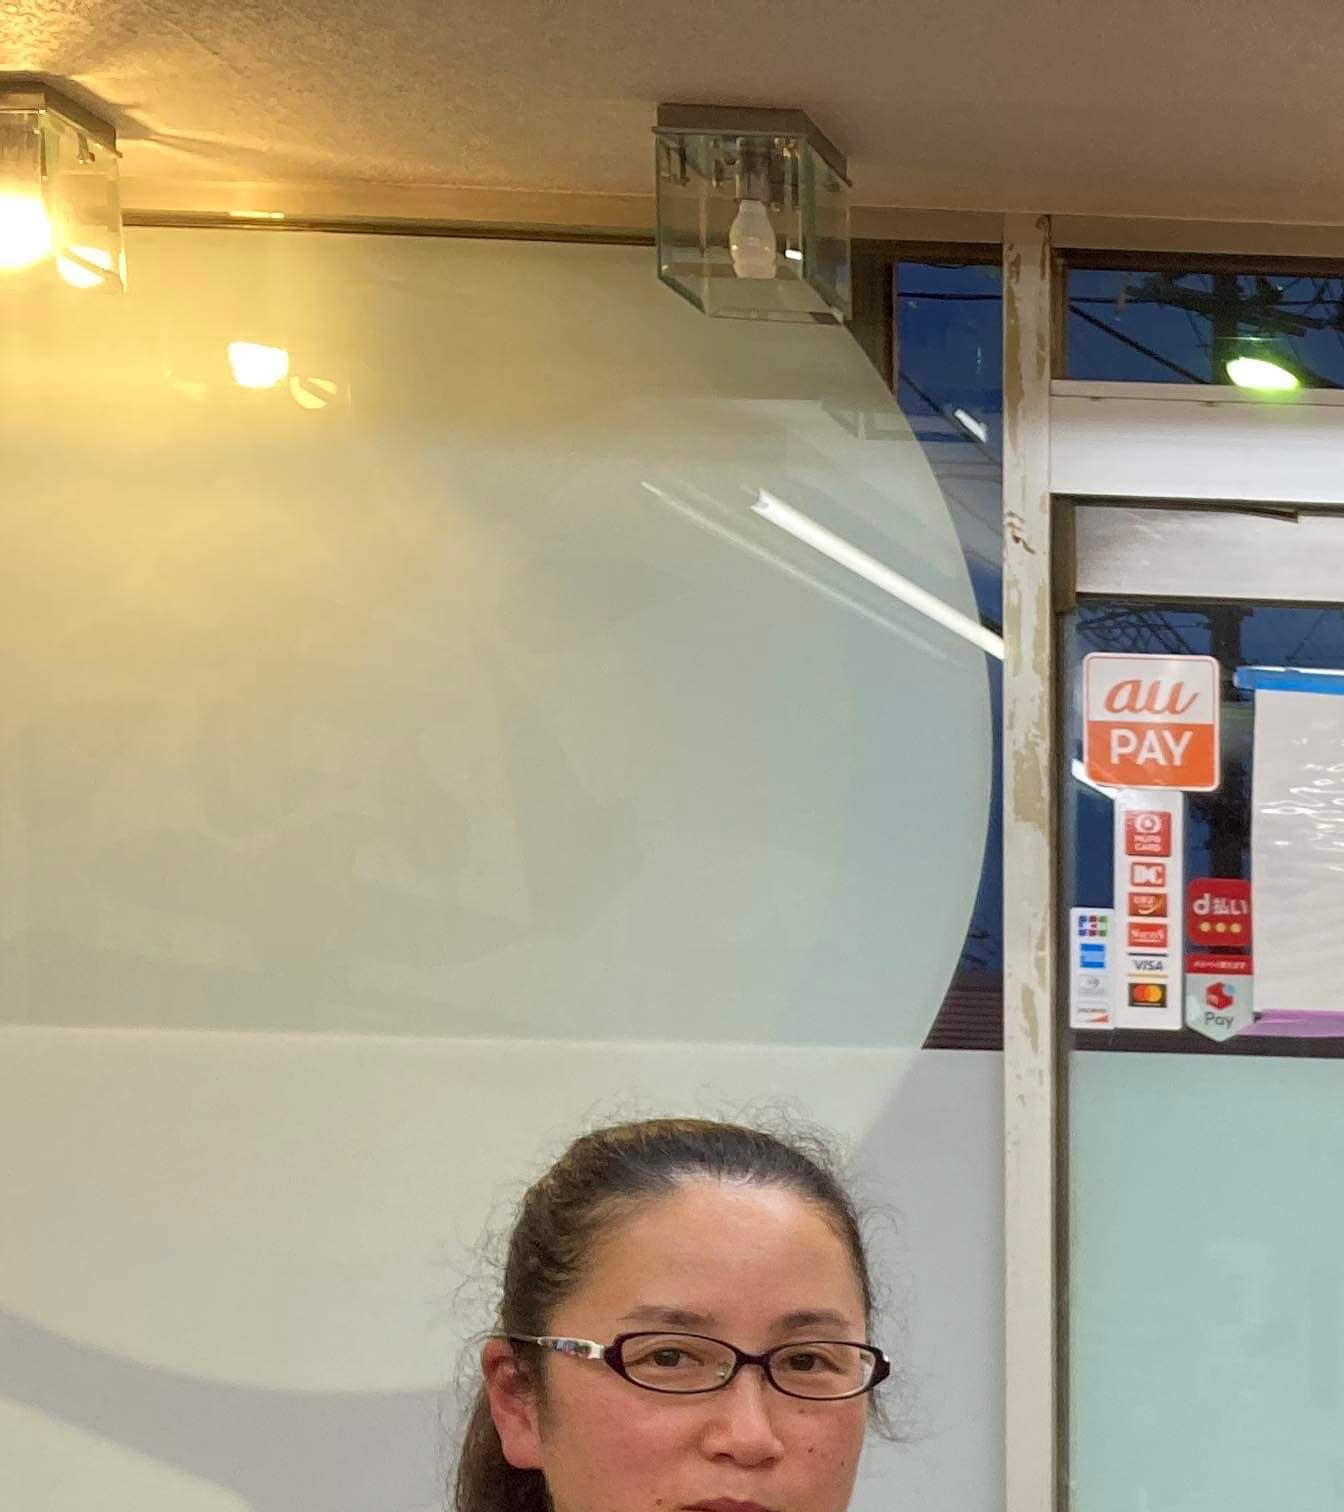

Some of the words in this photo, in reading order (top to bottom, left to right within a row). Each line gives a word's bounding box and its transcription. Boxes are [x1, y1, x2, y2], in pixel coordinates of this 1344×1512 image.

[1104, 679, 1199, 715] au
[1110, 728, 1193, 766] PAY
[1132, 959, 1163, 971] VISA
[1204, 1011, 1234, 1029] Pay
